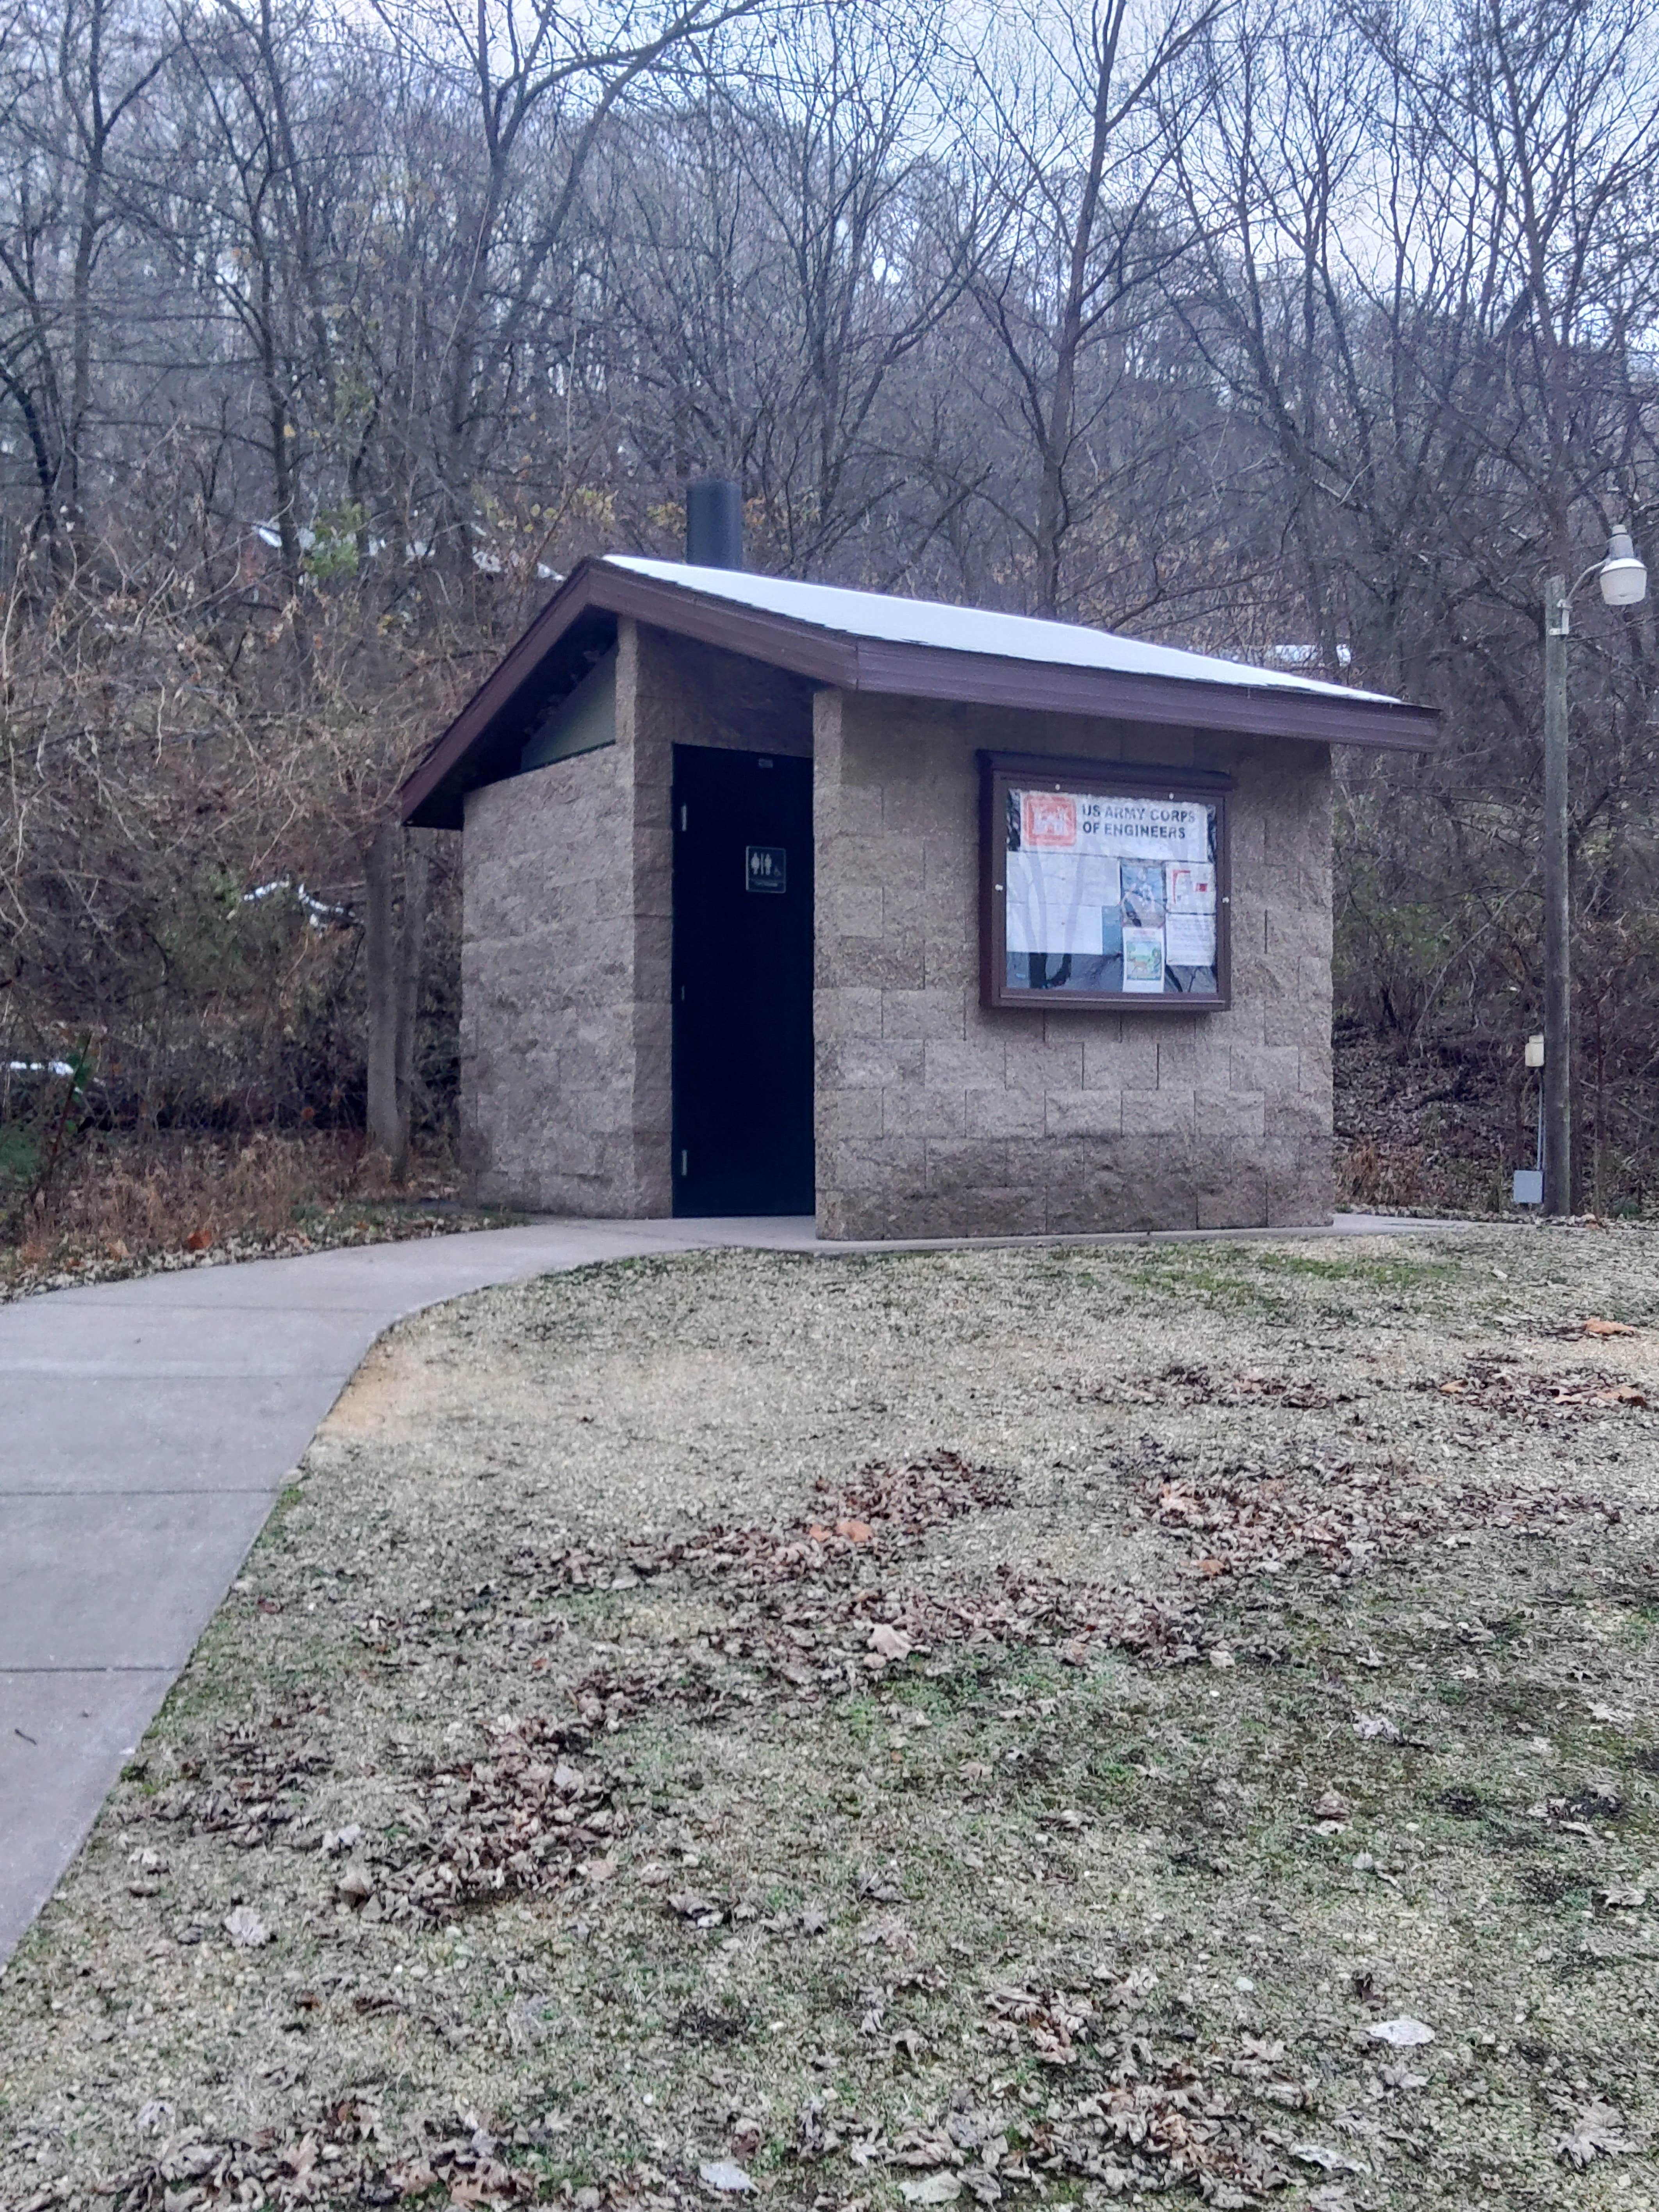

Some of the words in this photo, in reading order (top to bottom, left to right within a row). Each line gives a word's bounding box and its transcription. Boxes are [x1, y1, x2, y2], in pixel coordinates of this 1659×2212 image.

[1082, 803, 1101, 817] US
[1105, 805, 1145, 820] ARMY
[1150, 809, 1195, 823] CORPS
[1083, 821, 1100, 834] OF
[1104, 823, 1186, 839] ENGINEERS
